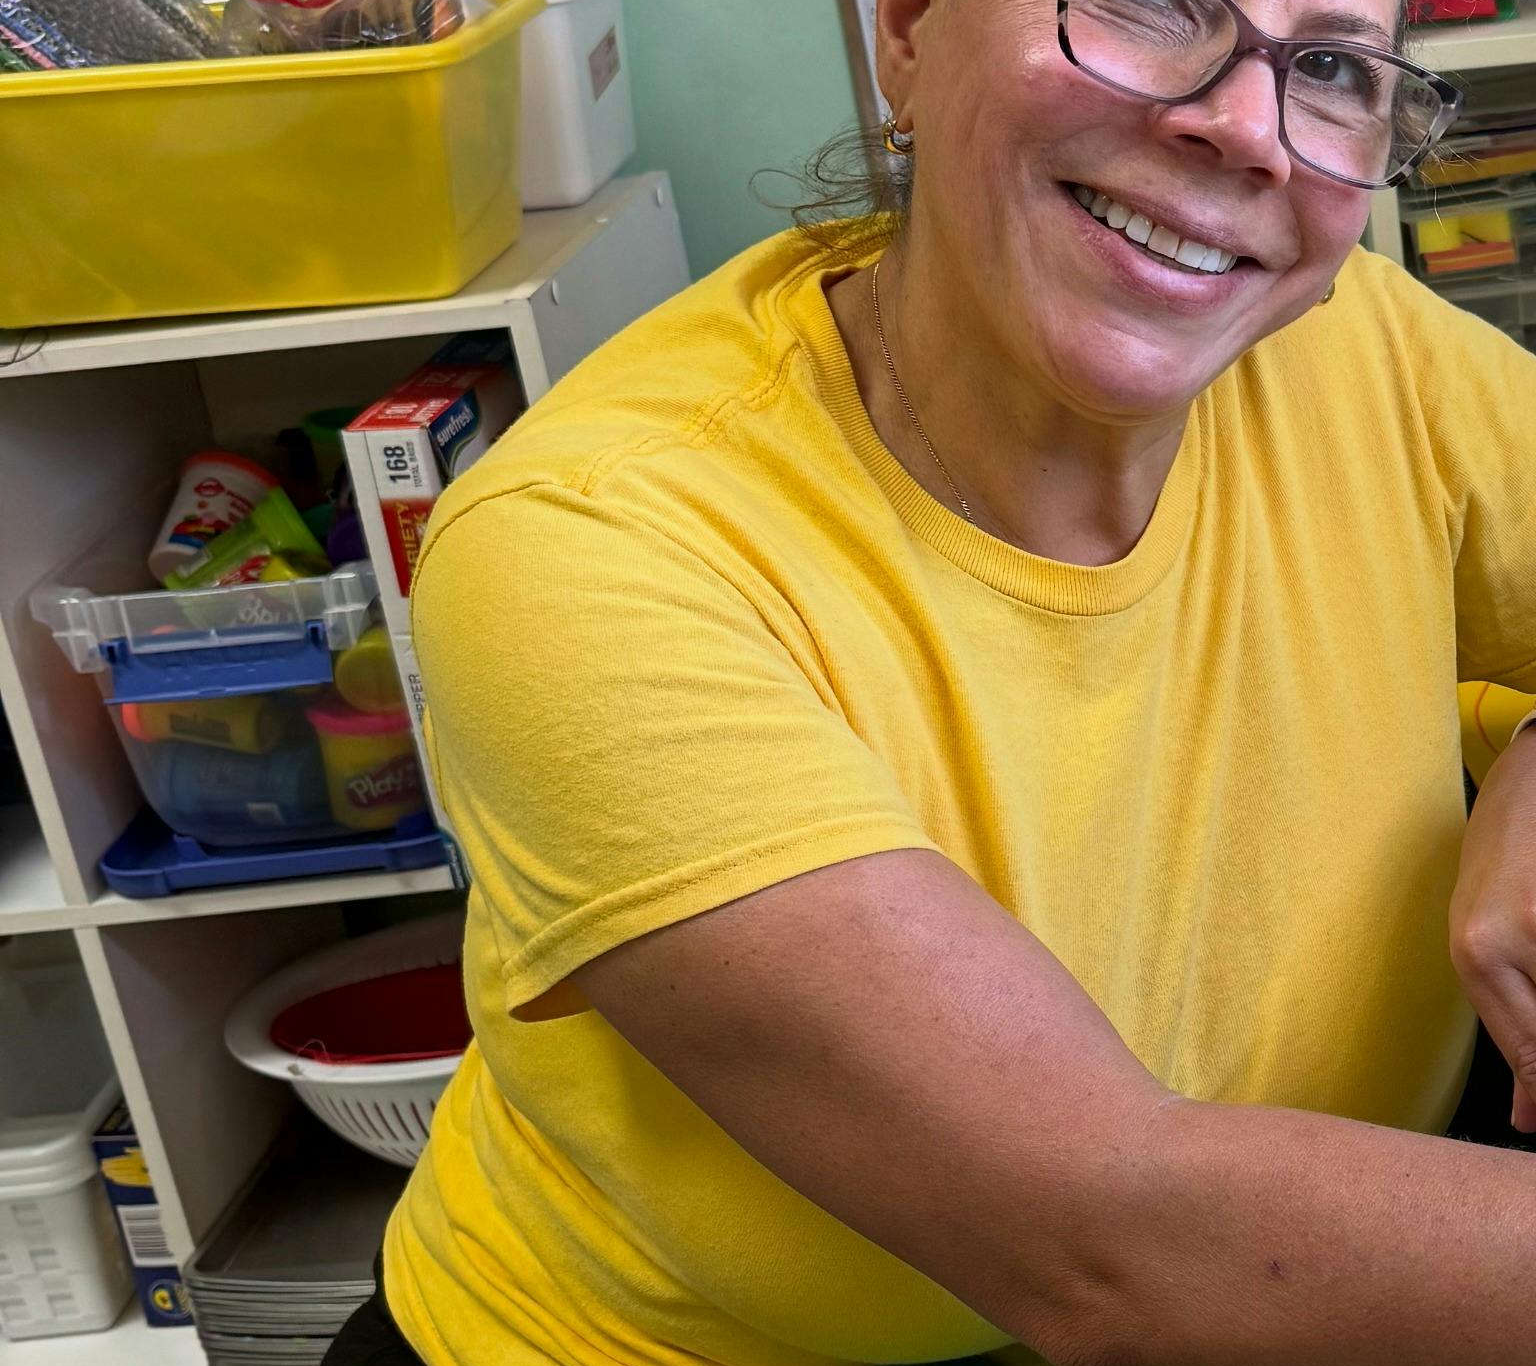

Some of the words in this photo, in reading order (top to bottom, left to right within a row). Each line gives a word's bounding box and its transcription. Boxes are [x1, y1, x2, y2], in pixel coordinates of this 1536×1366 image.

[435, 402, 476, 447] surefresh
[382, 444, 411, 484] 168
[412, 463, 423, 488] TOTAL
